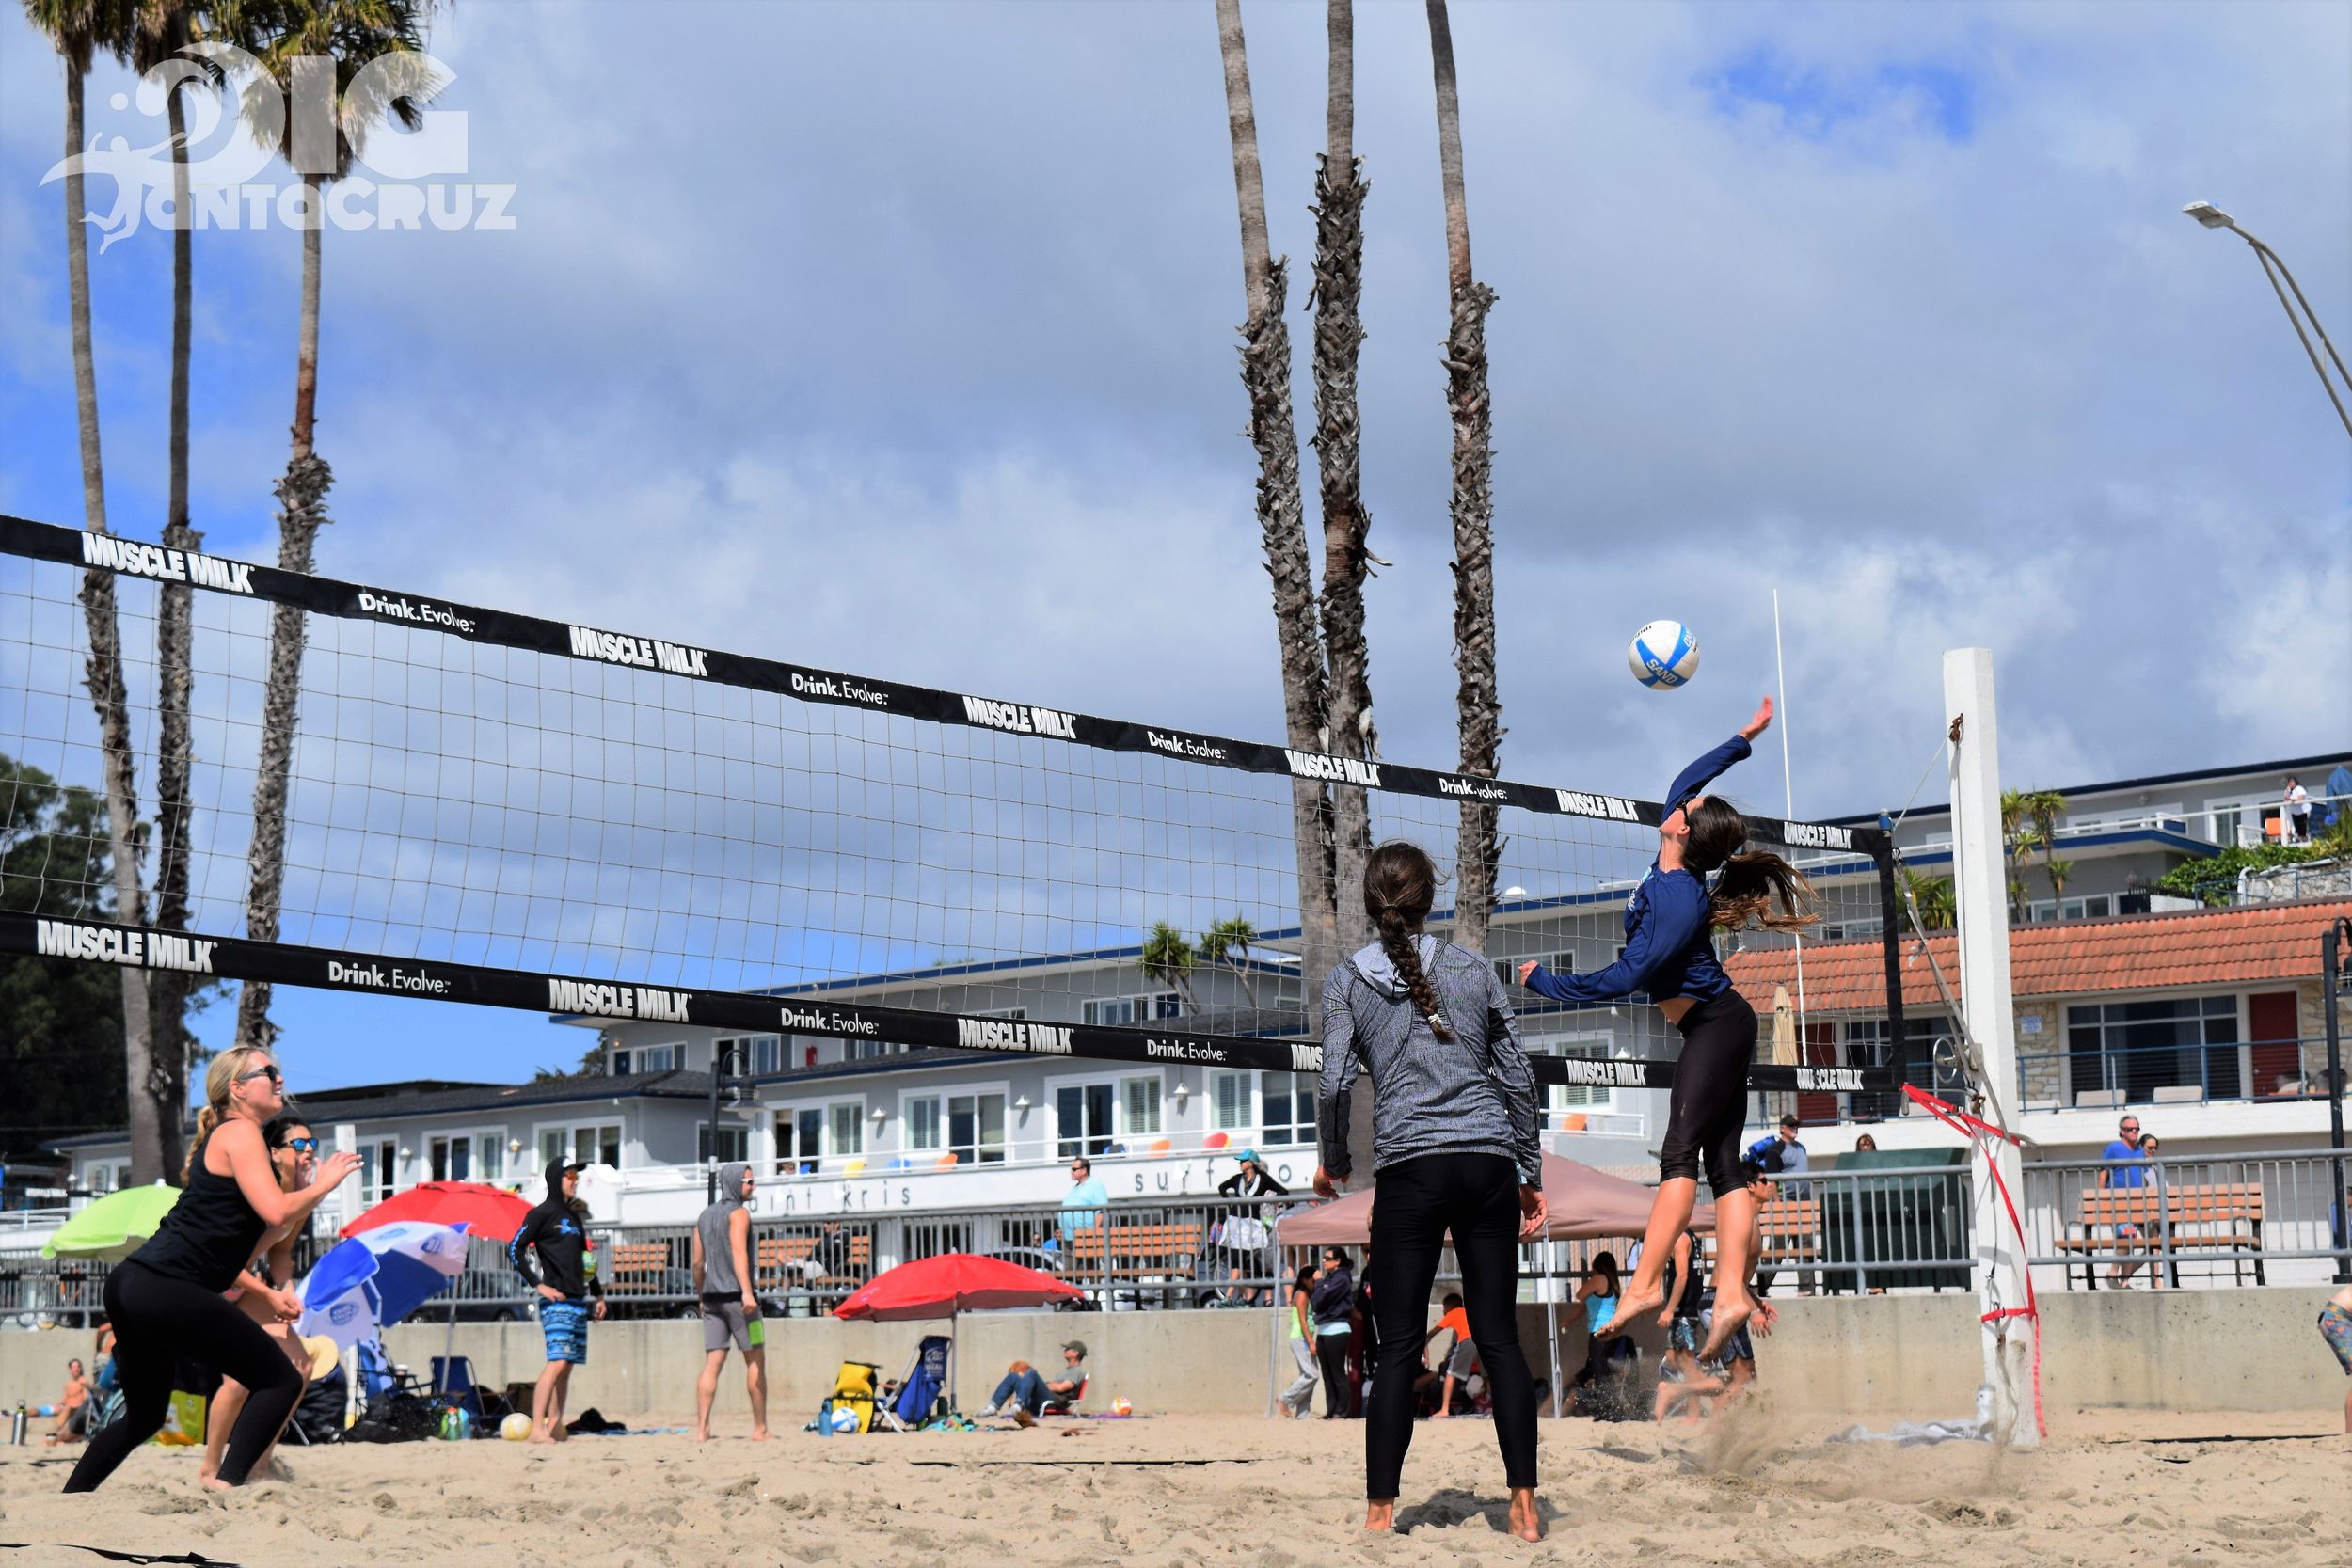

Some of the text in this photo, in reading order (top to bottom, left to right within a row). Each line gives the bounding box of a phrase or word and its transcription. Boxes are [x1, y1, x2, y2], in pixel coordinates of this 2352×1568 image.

[82, 531, 254, 594] MUSCLE MILK
[358, 594, 421, 621] Drink.
[569, 626, 708, 677] MUSCLE MILK
[1646, 659, 1678, 684] SAND
[791, 673, 842, 698] Drink.
[962, 696, 1077, 739] MUSCLE MILK
[1147, 731, 1186, 754] Drink.
[1284, 750, 1381, 786] MUSCLE MILK
[1438, 778, 1477, 796] Drink.
[1555, 789, 1639, 821] MUSCLE MILK
[1784, 821, 1851, 849] MUSCLE MILK
[37, 919, 213, 973] MUSCLE MILK
[328, 961, 389, 988] Drink.
[548, 978, 690, 1022] MUSCLE MILK
[781, 1008, 830, 1031] Drink.
[958, 1018, 1073, 1054] MUSCLE MILK
[1147, 1039, 1187, 1059] Drink.
[1566, 1059, 1646, 1086] MUSCLE MILK
[1836, 1069, 1863, 1090] MILK
[842, 1180, 911, 1208] kris
